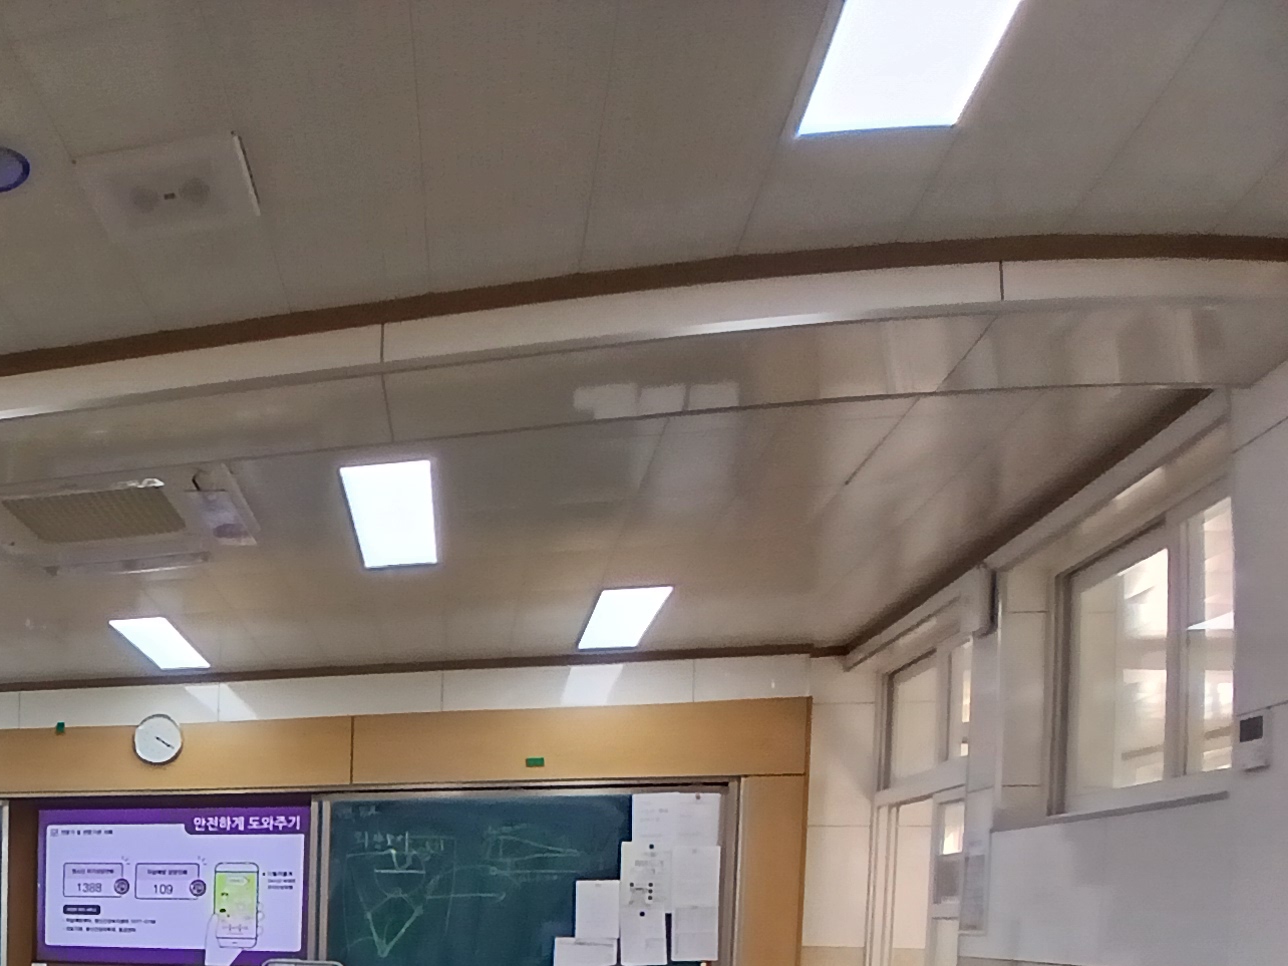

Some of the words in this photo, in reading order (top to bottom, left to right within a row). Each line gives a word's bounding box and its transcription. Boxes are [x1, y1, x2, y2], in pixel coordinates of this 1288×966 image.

[193, 815, 245, 832] 안전하게
[247, 815, 301, 831] 도와주기
[76, 882, 103, 893] 1388
[153, 883, 174, 895] 109
